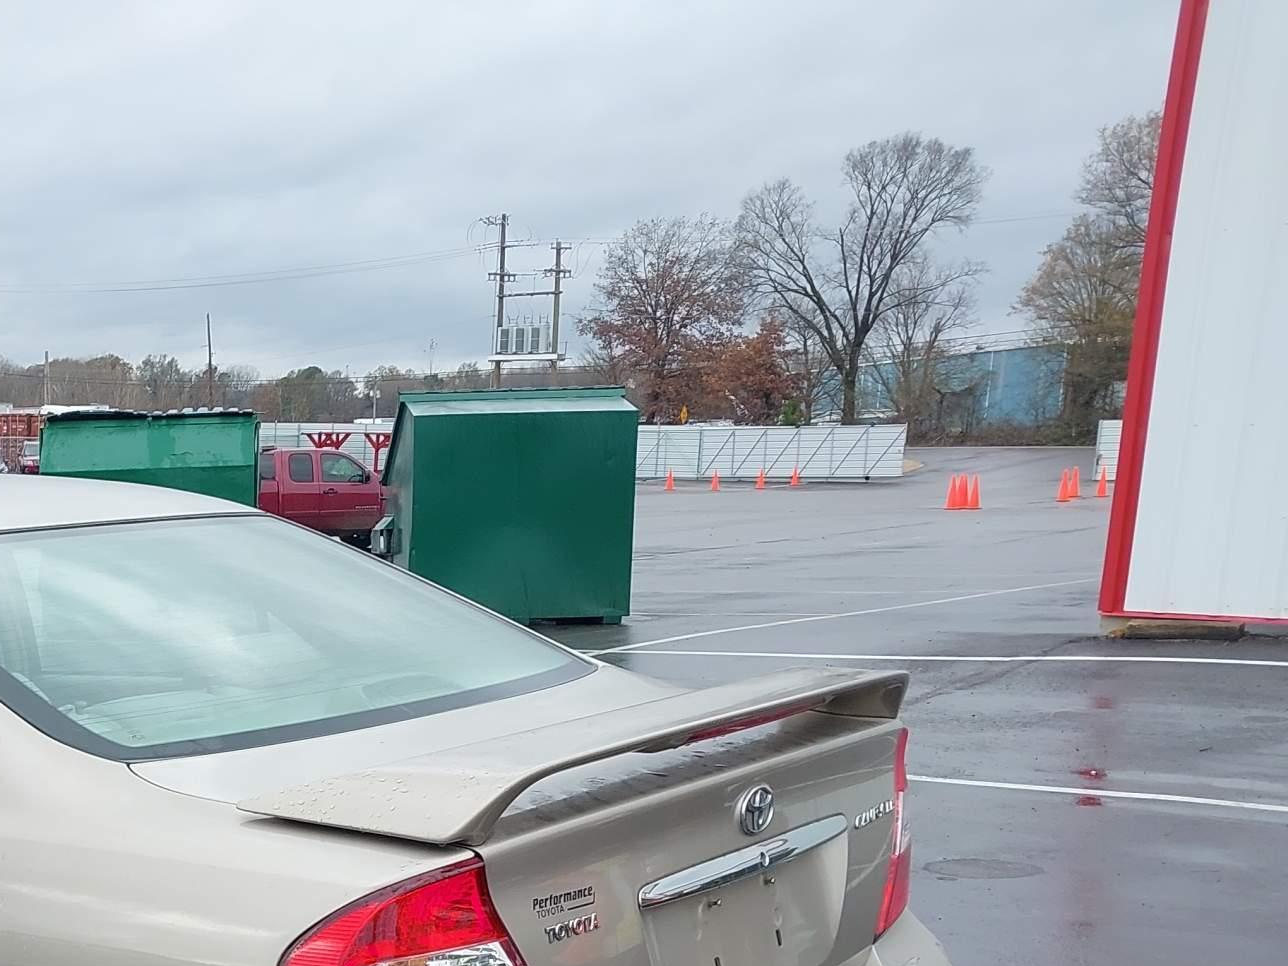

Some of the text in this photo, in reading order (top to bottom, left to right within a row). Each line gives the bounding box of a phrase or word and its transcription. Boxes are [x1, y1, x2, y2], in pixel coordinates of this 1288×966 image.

[532, 885, 593, 910] Performance
[536, 905, 565, 919] TOYOTA
[544, 912, 600, 944] TOYOTA
